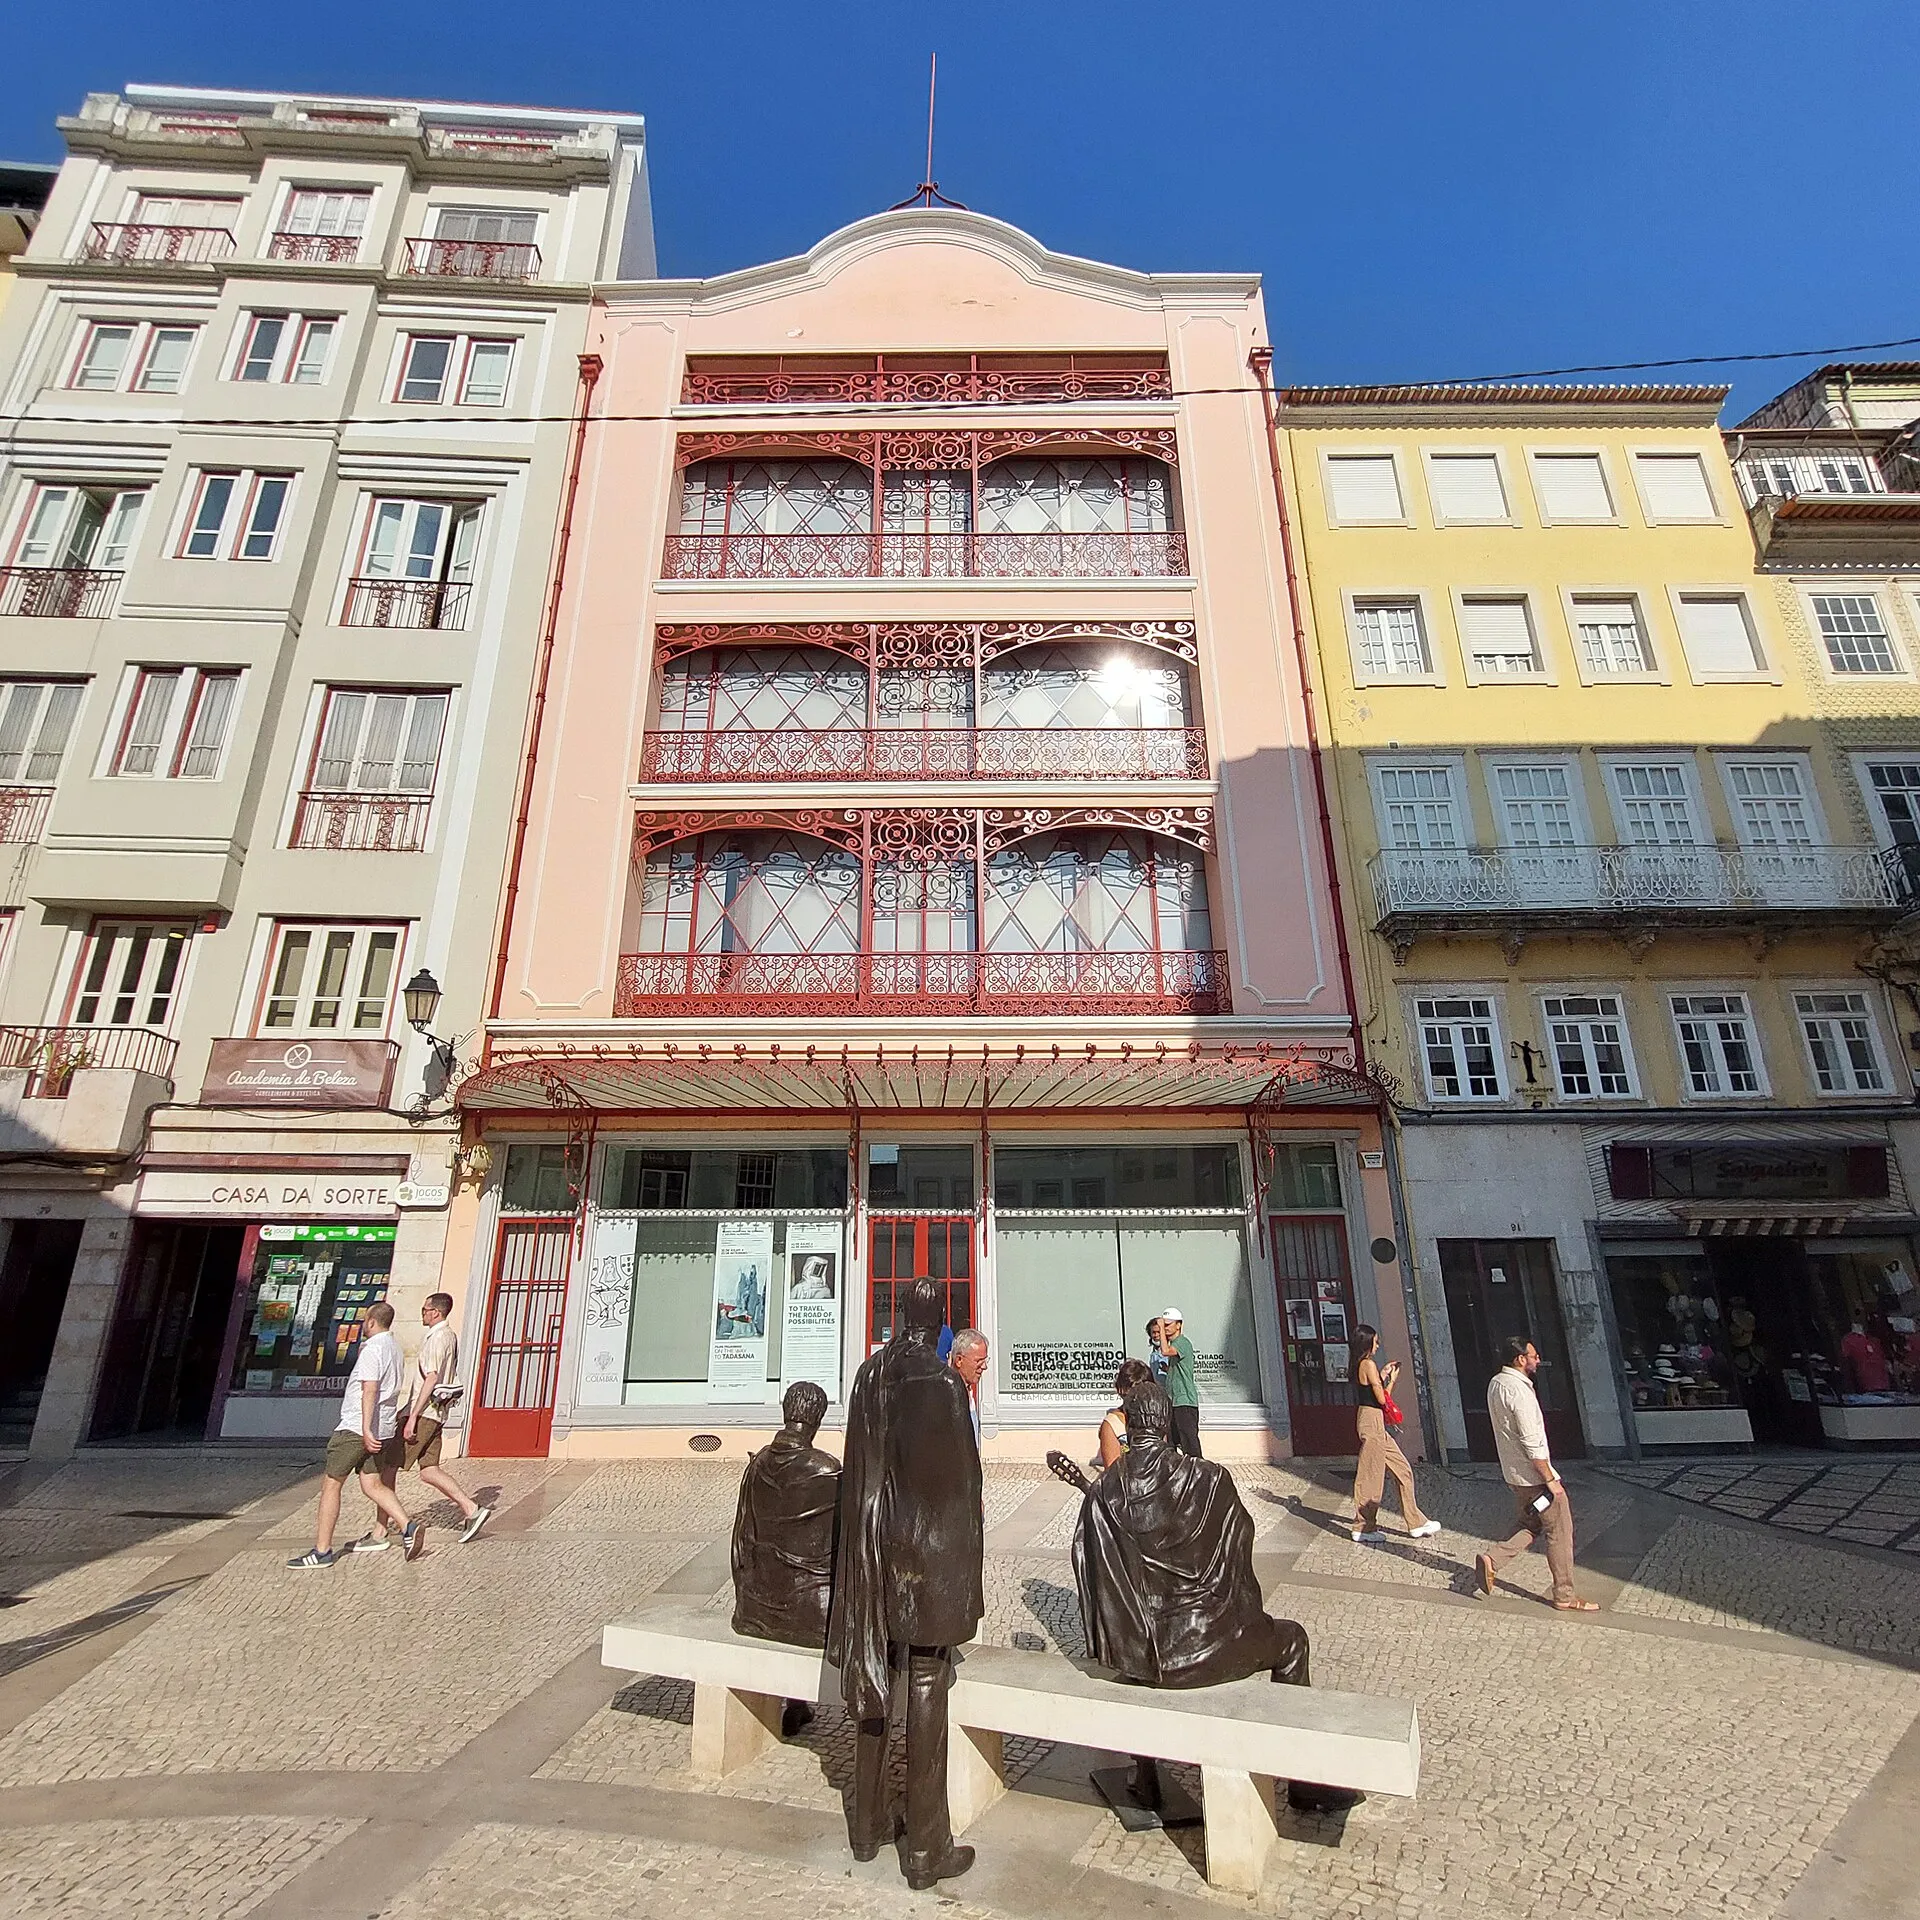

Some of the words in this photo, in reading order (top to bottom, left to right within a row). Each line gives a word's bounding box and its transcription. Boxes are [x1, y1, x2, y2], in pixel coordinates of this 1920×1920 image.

[227, 1069, 293, 1086] Academia
[294, 1069, 312, 1085] de
[313, 1070, 357, 1086] Beleza
[212, 1187, 270, 1204] CASA
[282, 1188, 312, 1204] DA
[324, 1188, 388, 1205] SORTE
[415, 1188, 443, 1199] JOGOS
[1511, 1223, 1521, 1232] 91
[1073, 1351, 1124, 1361] CHIADO
